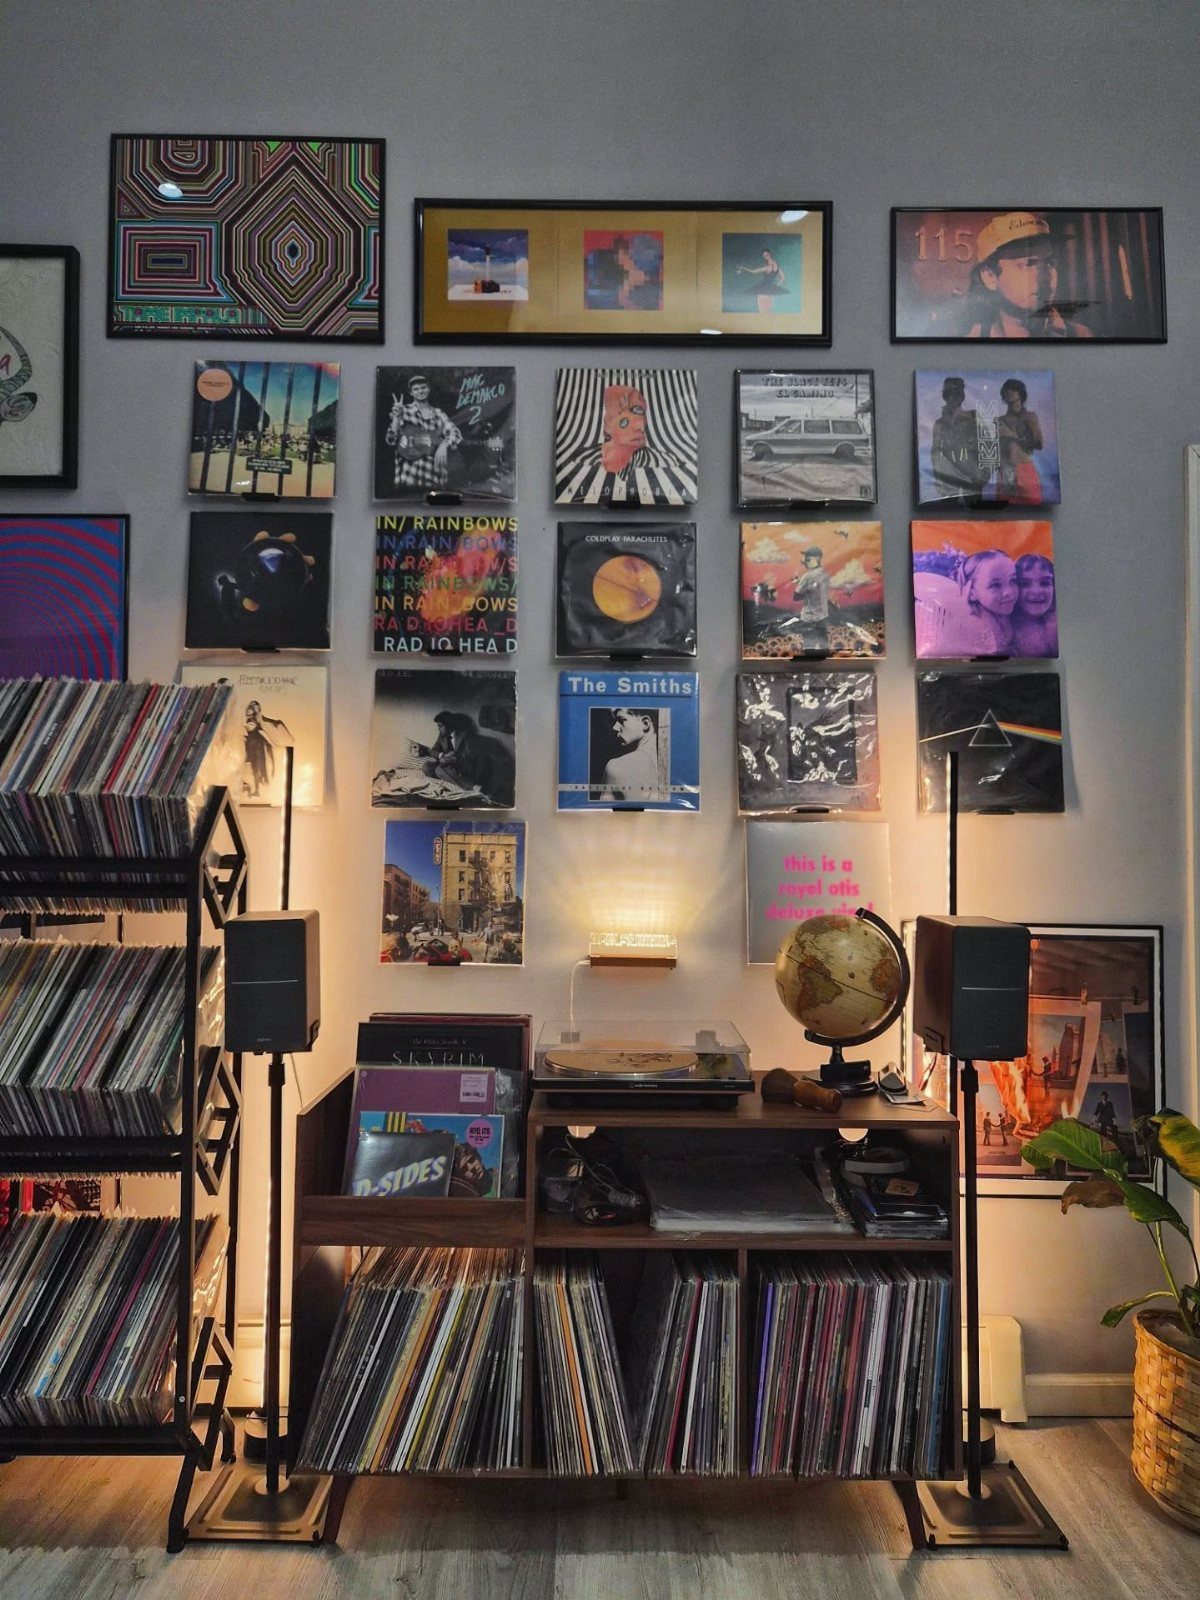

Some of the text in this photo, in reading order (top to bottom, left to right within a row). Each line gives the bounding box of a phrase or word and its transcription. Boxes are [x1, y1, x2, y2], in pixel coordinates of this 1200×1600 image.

[915, 227, 978, 263] 115
[459, 373, 485, 393] MAC
[468, 406, 482, 426] 2
[376, 516, 519, 533] IN/ RAINBOWS
[375, 555, 397, 570] IN
[374, 596, 395, 611] IN
[384, 637, 423, 652] RAD
[459, 637, 499, 653] HEA
[506, 638, 518, 653] D
[568, 677, 693, 694] The Smiths
[783, 854, 854, 873] this is a
[778, 878, 860, 901] royel otis
[352, 1155, 448, 1197] D-SIDES
